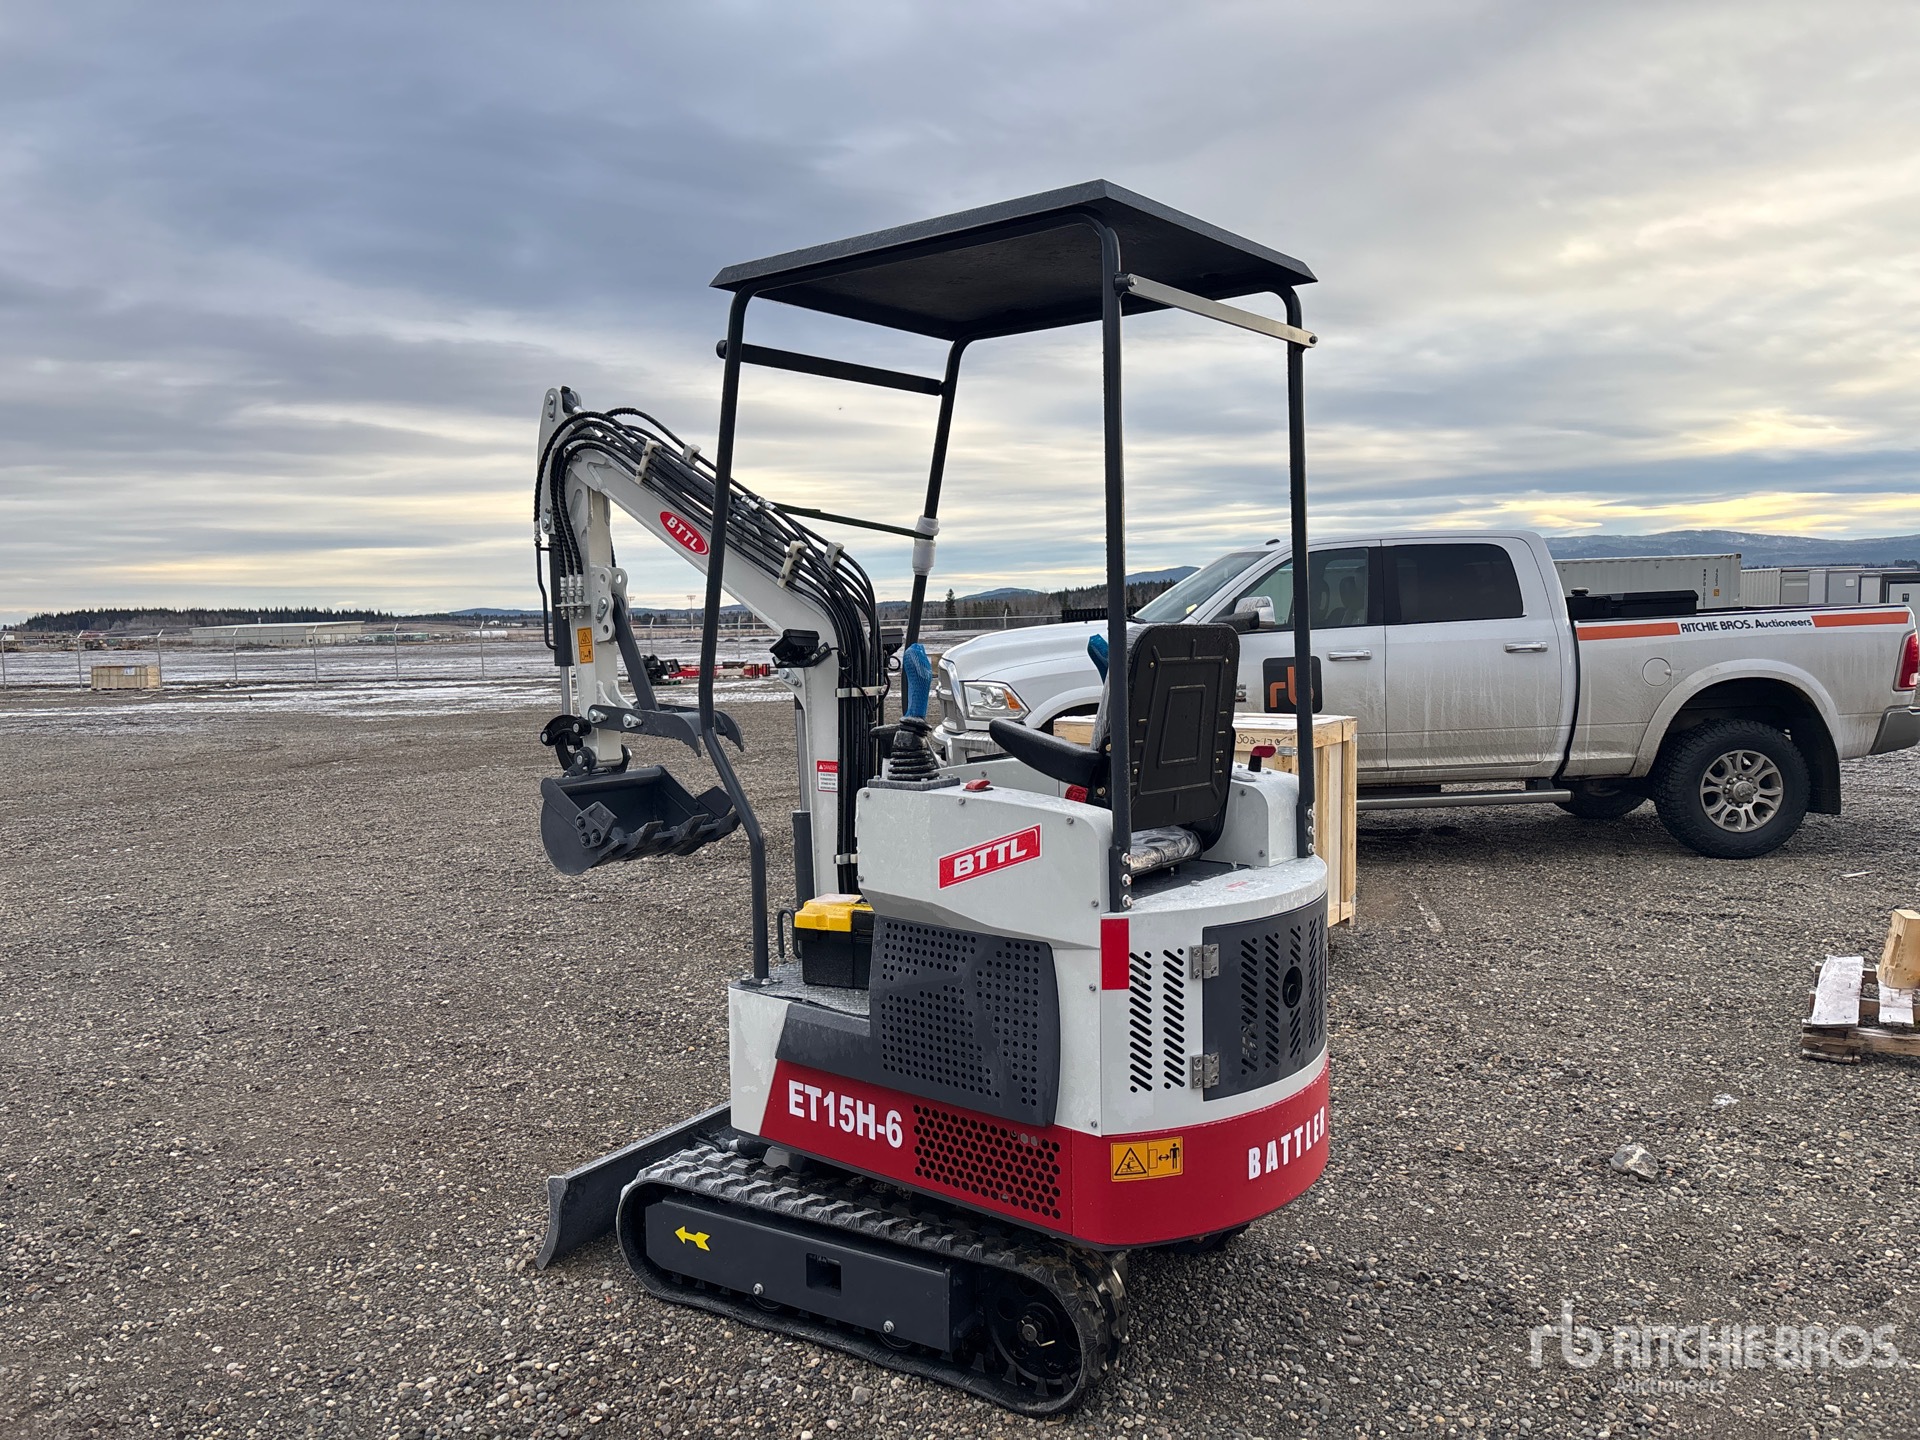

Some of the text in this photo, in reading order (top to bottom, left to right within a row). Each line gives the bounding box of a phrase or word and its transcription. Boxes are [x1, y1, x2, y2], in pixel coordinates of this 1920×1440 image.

[666, 516, 698, 550] BTTL
[1680, 619, 1813, 633] RITCHIE BROS. Auctioneers
[953, 838, 1028, 879] BTTL
[788, 1079, 903, 1149] ET15H-6
[1248, 1105, 1325, 1180] BATTLER
